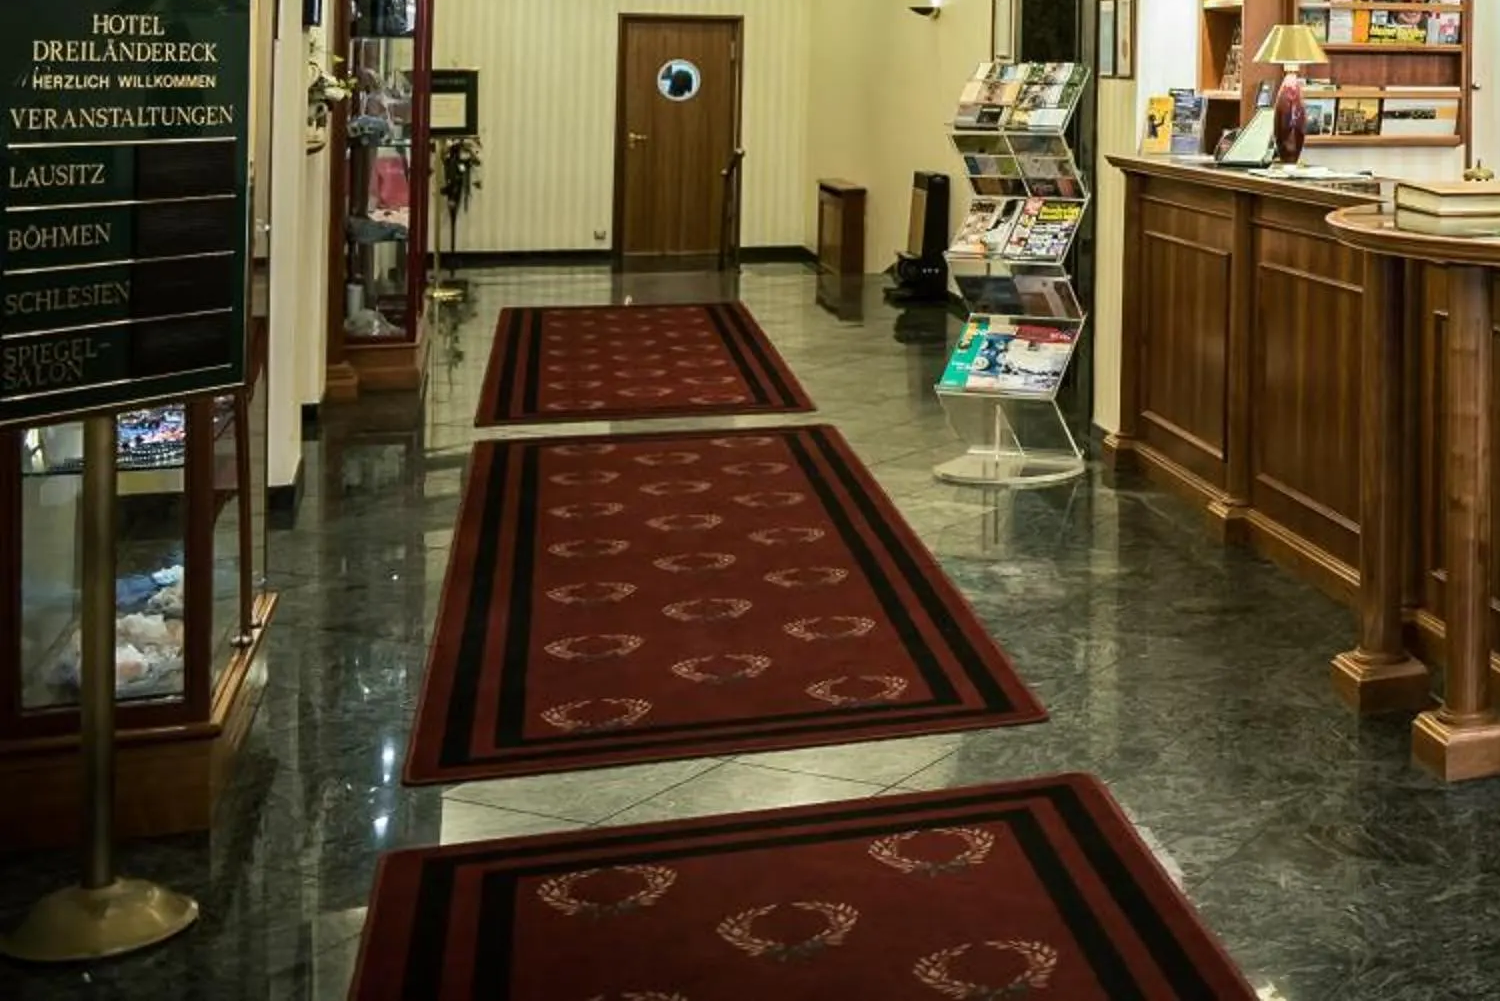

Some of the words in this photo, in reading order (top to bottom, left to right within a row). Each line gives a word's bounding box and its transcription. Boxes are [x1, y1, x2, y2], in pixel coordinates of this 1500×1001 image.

[92, 14, 165, 36] HOTEL
[32, 39, 218, 62] DREILÄNDERECK
[32, 74, 110, 89] HERZLICH
[118, 74, 216, 88] WILLKOMMEN
[9, 104, 234, 130] VERANSTALTUNGEN
[9, 164, 105, 188] LAUSITZ
[8, 224, 112, 250] BÖHMEN
[4, 280, 131, 315] SCHLESIEN
[3, 337, 111, 368] SPIEGEL-
[2, 358, 84, 390] SALON
